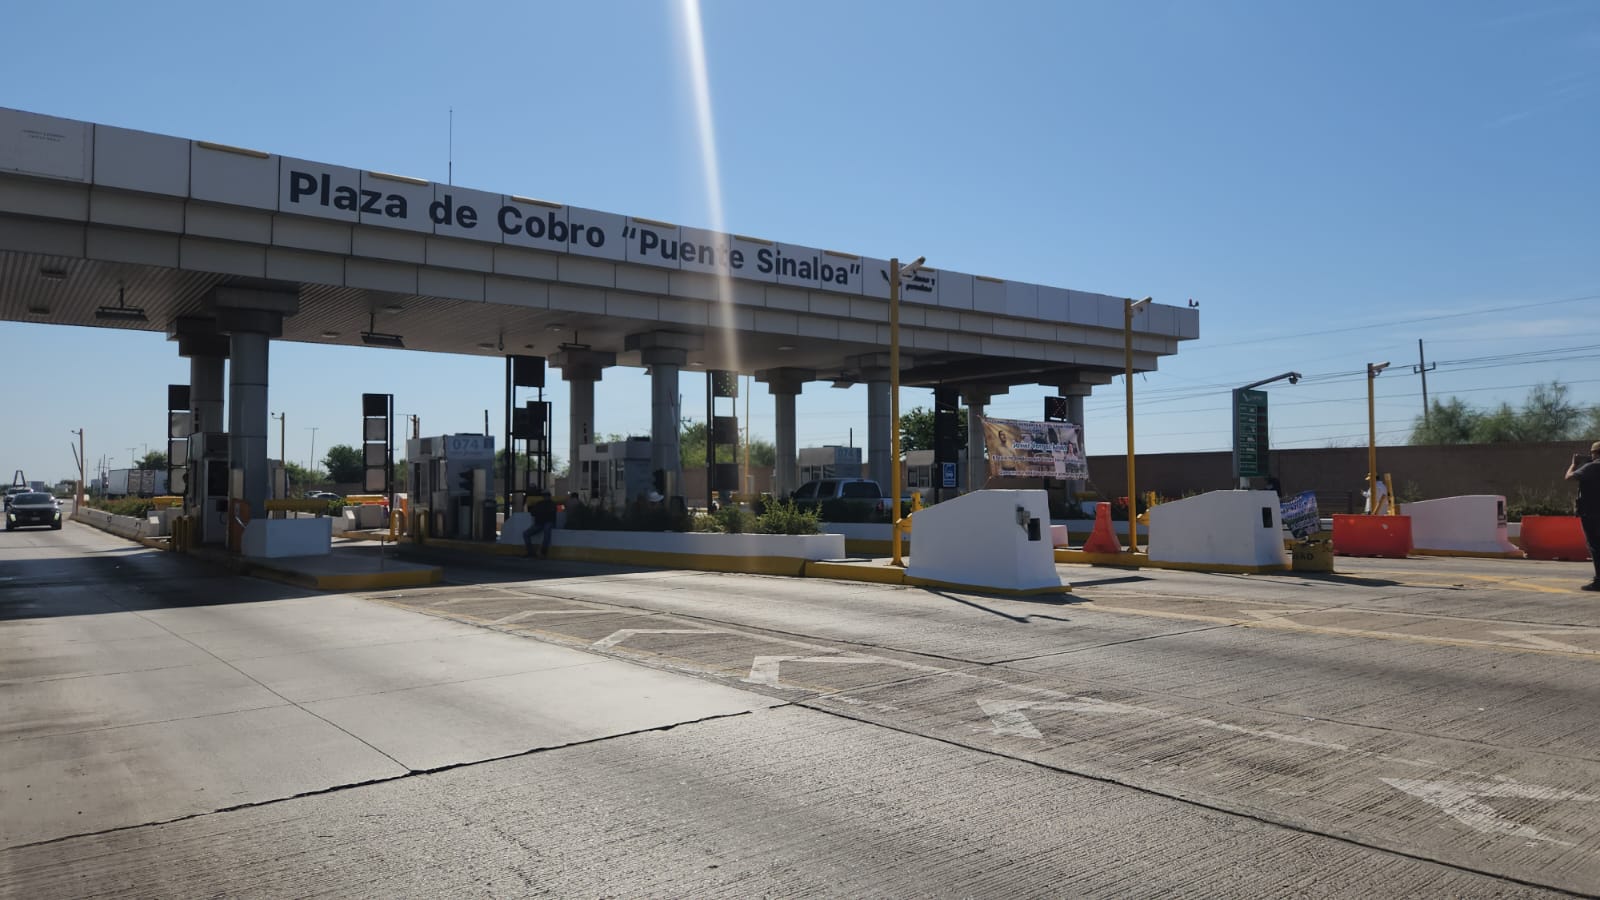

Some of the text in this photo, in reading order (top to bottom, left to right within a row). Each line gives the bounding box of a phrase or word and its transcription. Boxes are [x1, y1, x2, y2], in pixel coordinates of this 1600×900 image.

[290, 171, 408, 219] Plaza
[429, 194, 478, 229] de
[497, 205, 606, 248] Cobro
[757, 248, 861, 285] Sinaloa”
[452, 439, 478, 450] 074
